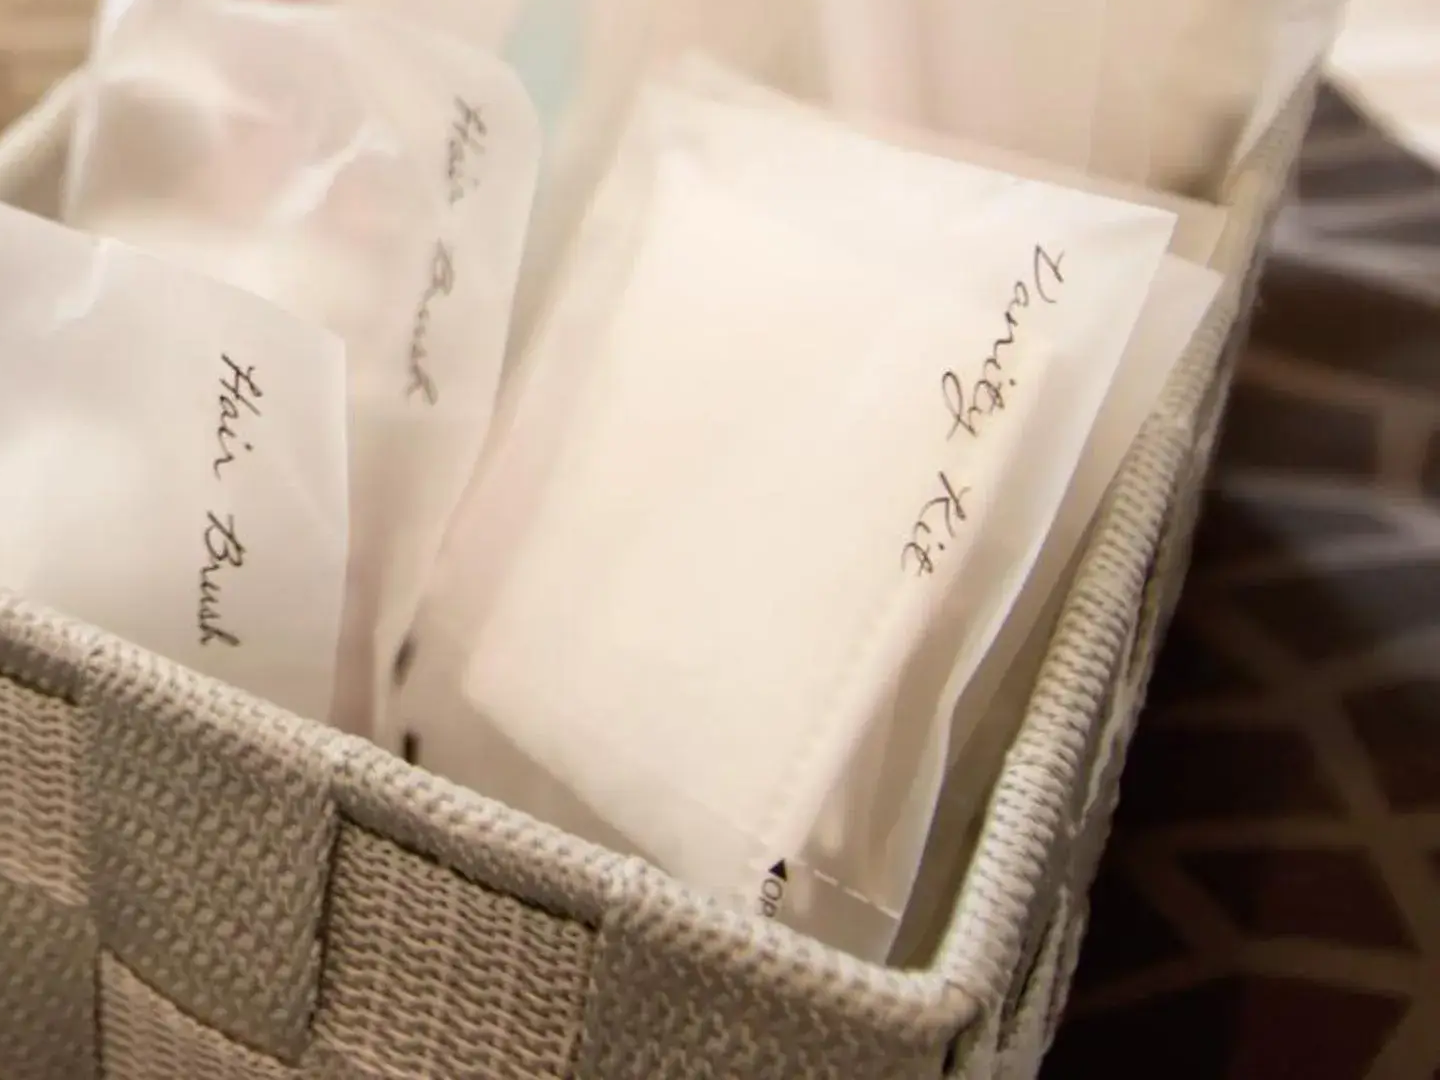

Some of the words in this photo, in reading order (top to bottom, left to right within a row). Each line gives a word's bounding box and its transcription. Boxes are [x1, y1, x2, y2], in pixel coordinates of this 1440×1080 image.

[940, 243, 1066, 442] Vanity
[218, 352, 264, 480] Hair
[196, 508, 249, 648] Brush
[901, 470, 972, 578] Kit
